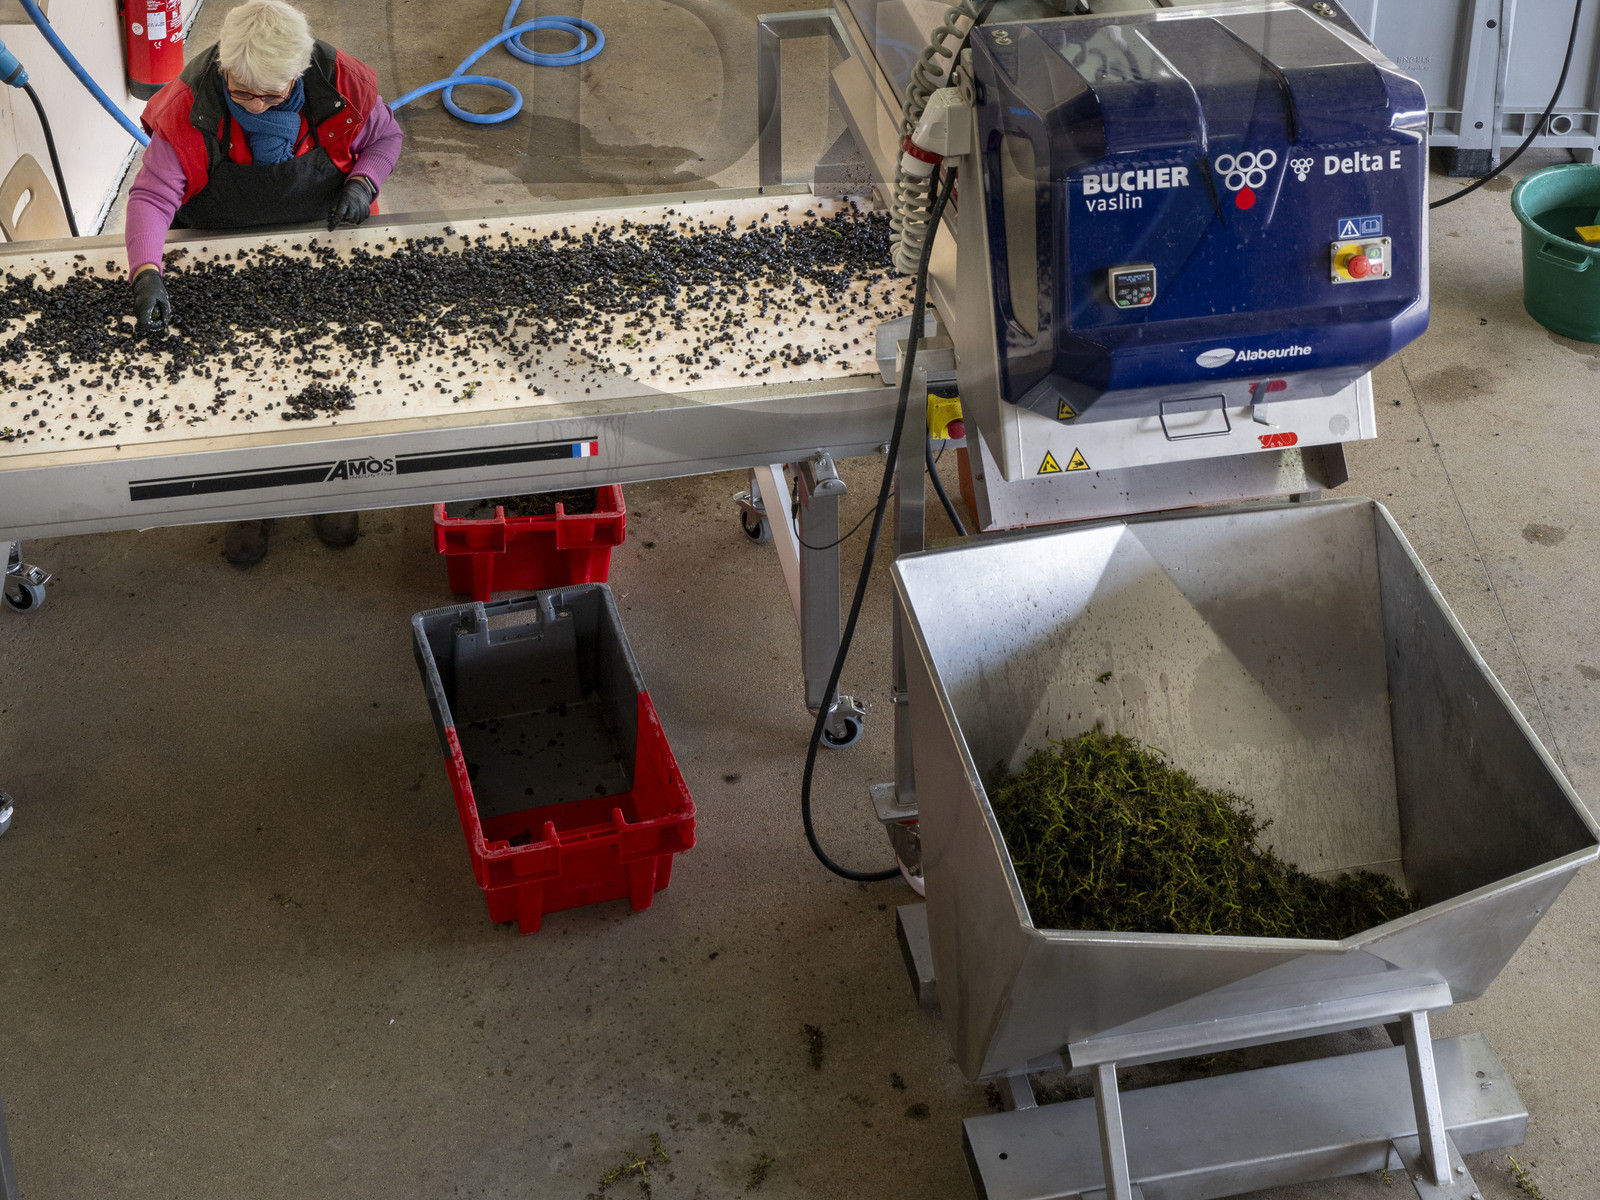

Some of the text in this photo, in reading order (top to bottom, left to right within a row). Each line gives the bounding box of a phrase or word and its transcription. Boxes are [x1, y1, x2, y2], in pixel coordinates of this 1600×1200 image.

[1324, 149, 1402, 176] Delta E
[1082, 166, 1190, 196] BUCHER
[1086, 193, 1143, 212] vaslin
[1235, 345, 1312, 362] Alabeurthe
